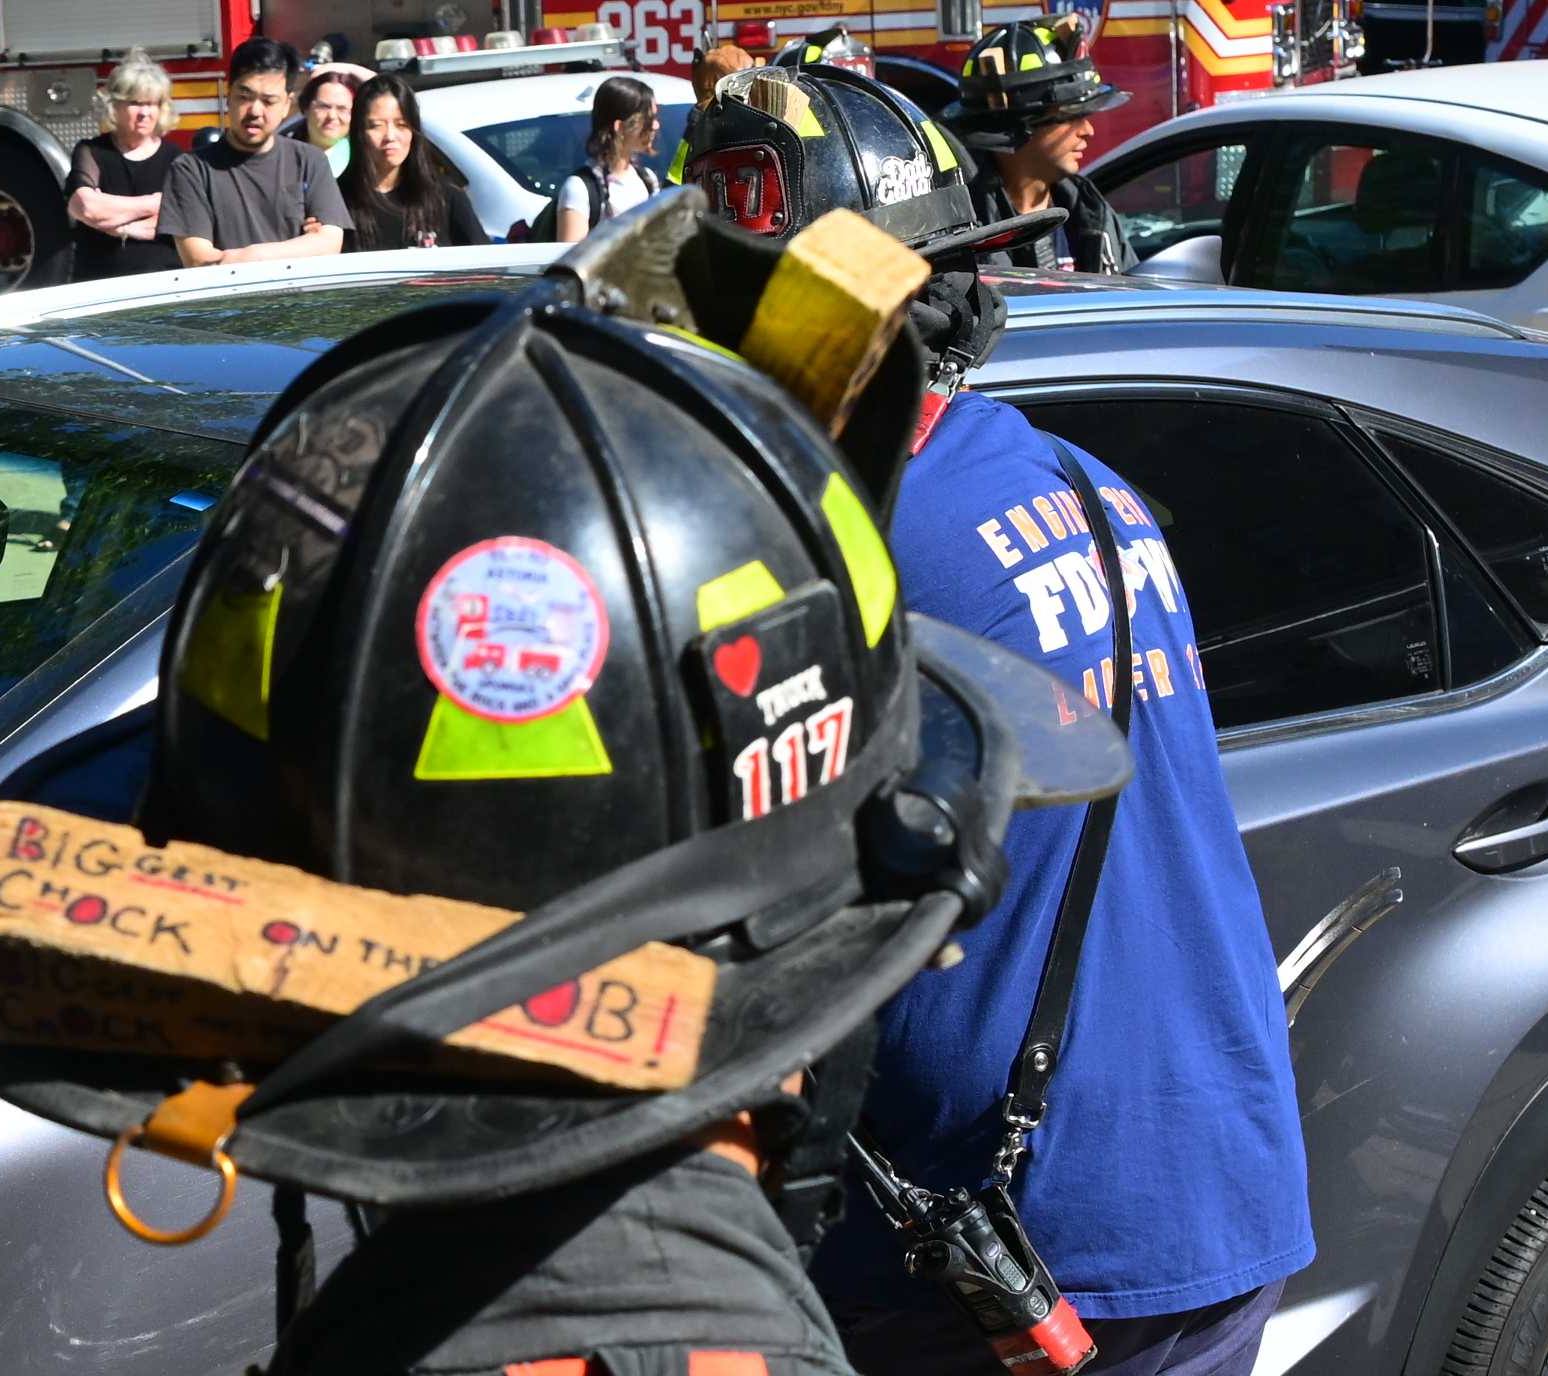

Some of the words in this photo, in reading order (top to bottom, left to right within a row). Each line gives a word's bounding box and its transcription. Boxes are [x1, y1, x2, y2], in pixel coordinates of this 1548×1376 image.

[976, 489, 1091, 569] ENGIN
[1051, 648, 1175, 726] LAER
[732, 695, 854, 822] 117
[261, 920, 339, 963] ON
[515, 976, 679, 1071] OB!
